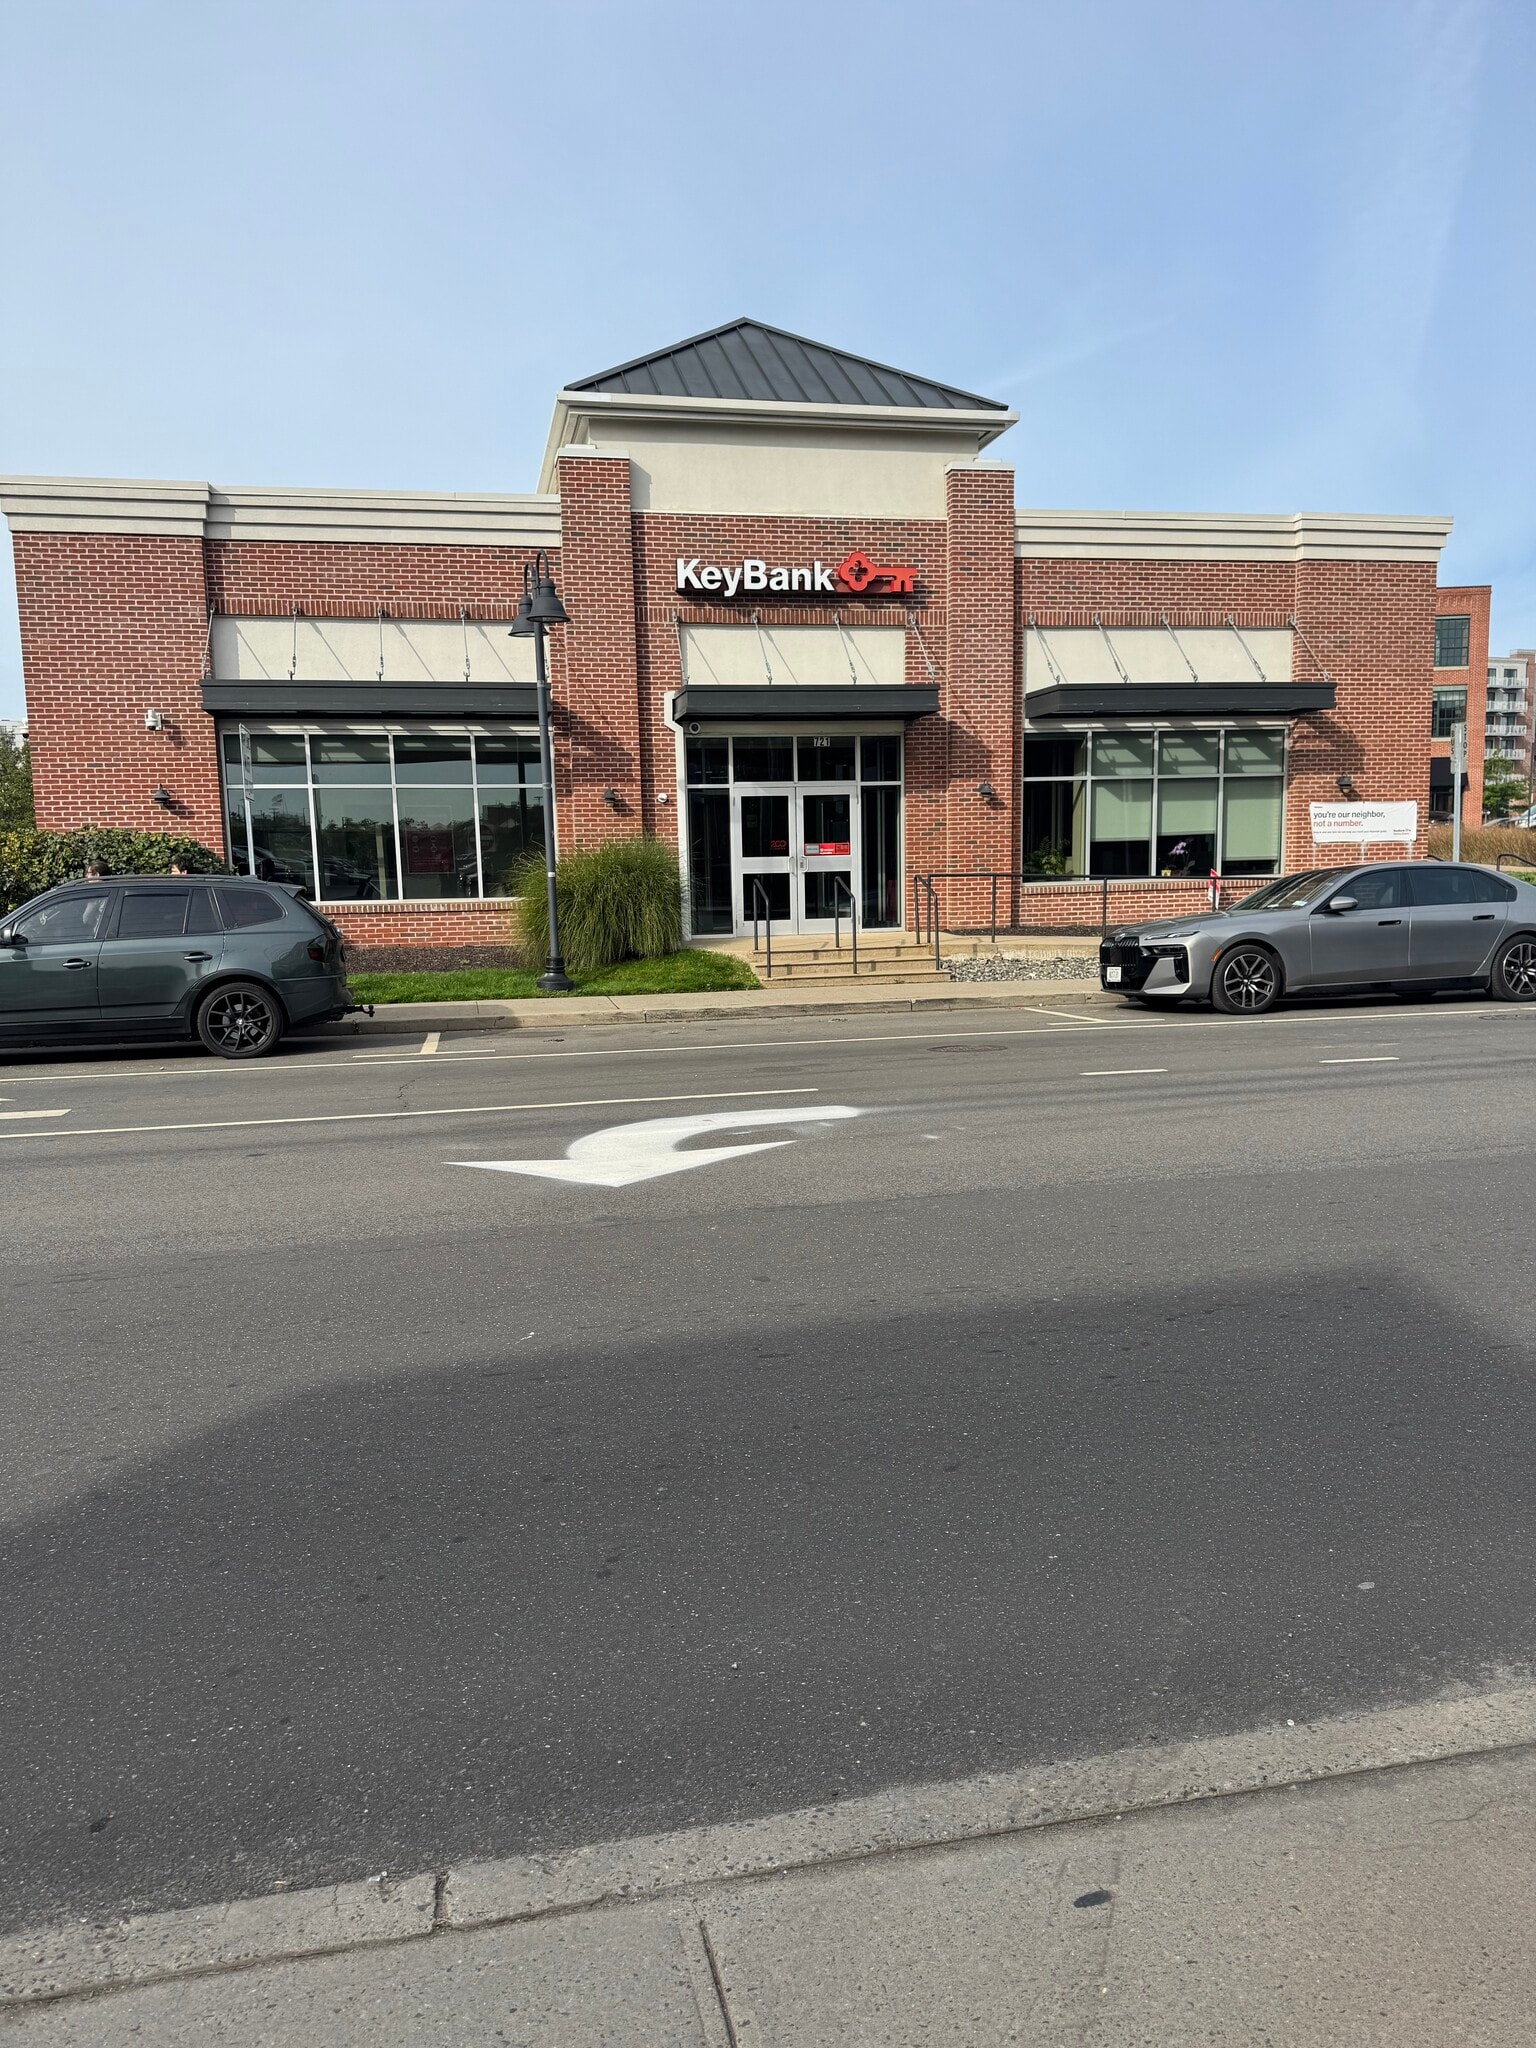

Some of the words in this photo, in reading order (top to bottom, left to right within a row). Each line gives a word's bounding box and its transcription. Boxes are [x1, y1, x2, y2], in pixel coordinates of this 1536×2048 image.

[676, 558, 835, 597] KeyBank
[814, 736, 831, 747] 721
[1313, 811, 1336, 819] you're
[1351, 811, 1386, 819] neighbor,
